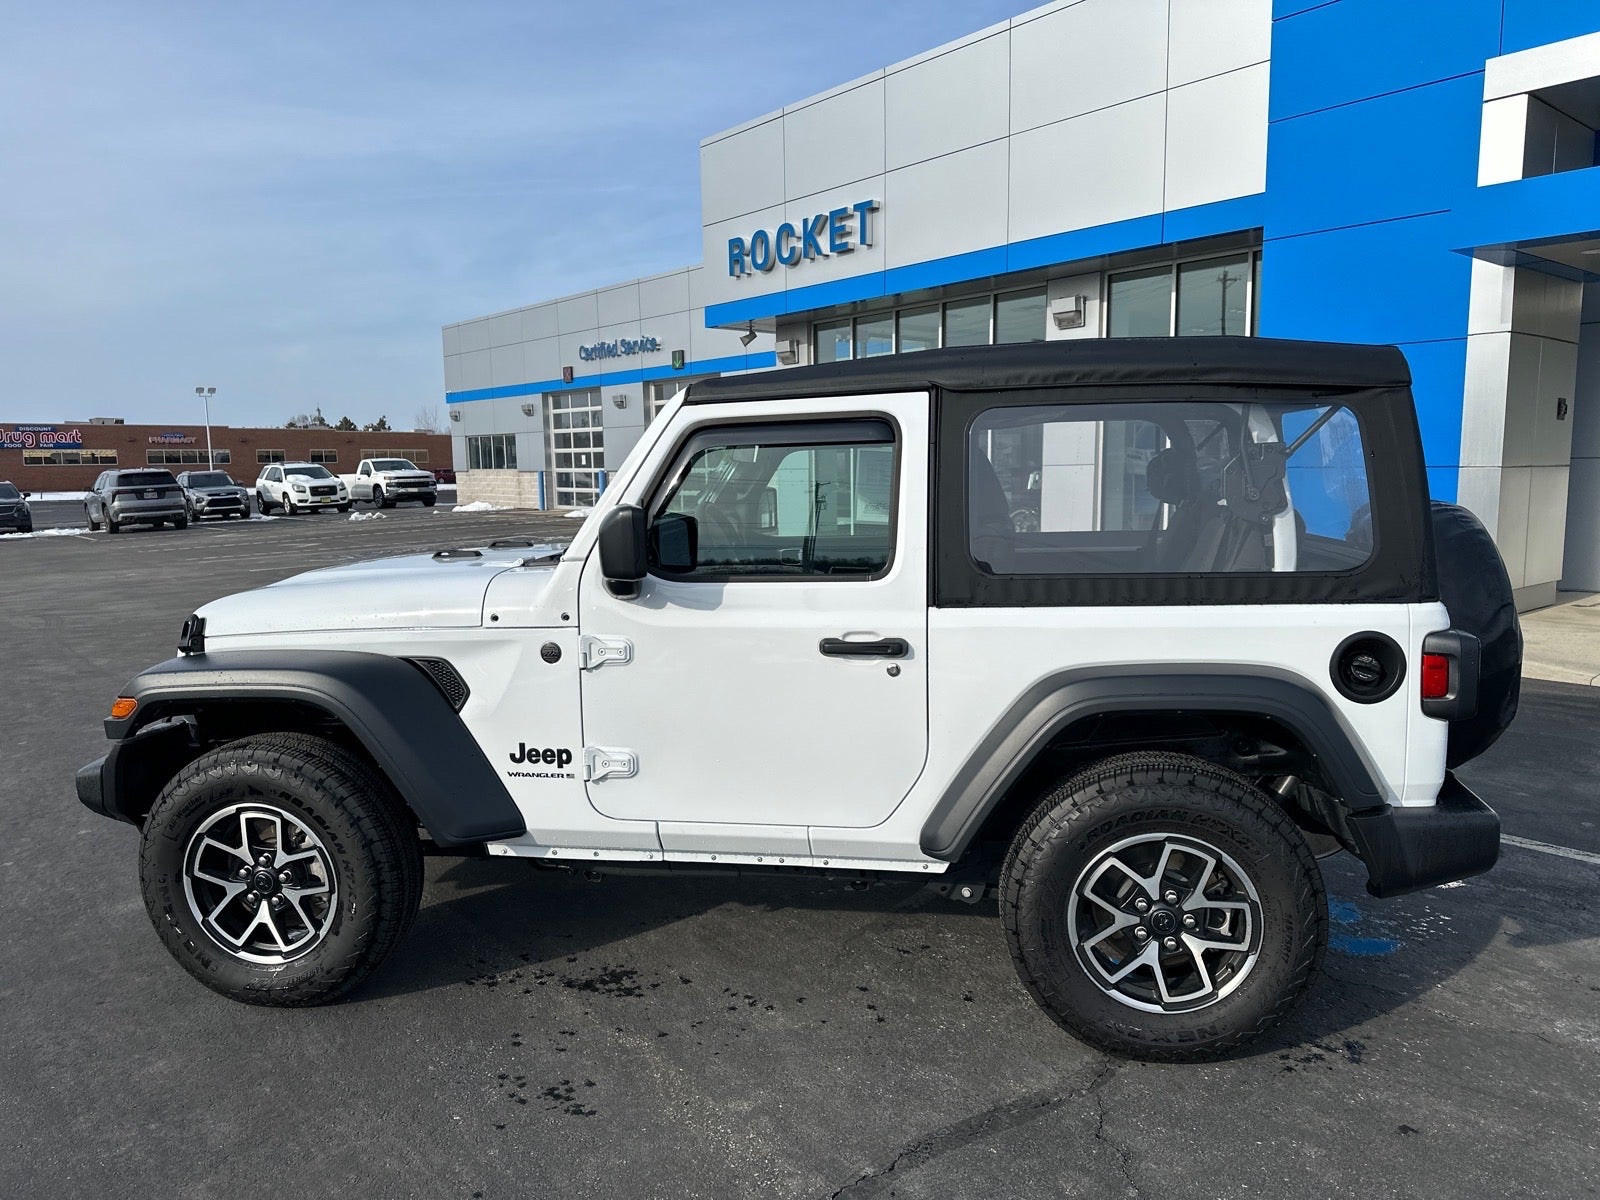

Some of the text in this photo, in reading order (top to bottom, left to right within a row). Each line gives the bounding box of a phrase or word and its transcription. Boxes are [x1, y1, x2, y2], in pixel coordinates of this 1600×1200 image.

[728, 199, 878, 277] ROCKET
[579, 335, 660, 361] Certified Service
[40, 429, 82, 443] mart
[509, 742, 573, 768] Jeep
